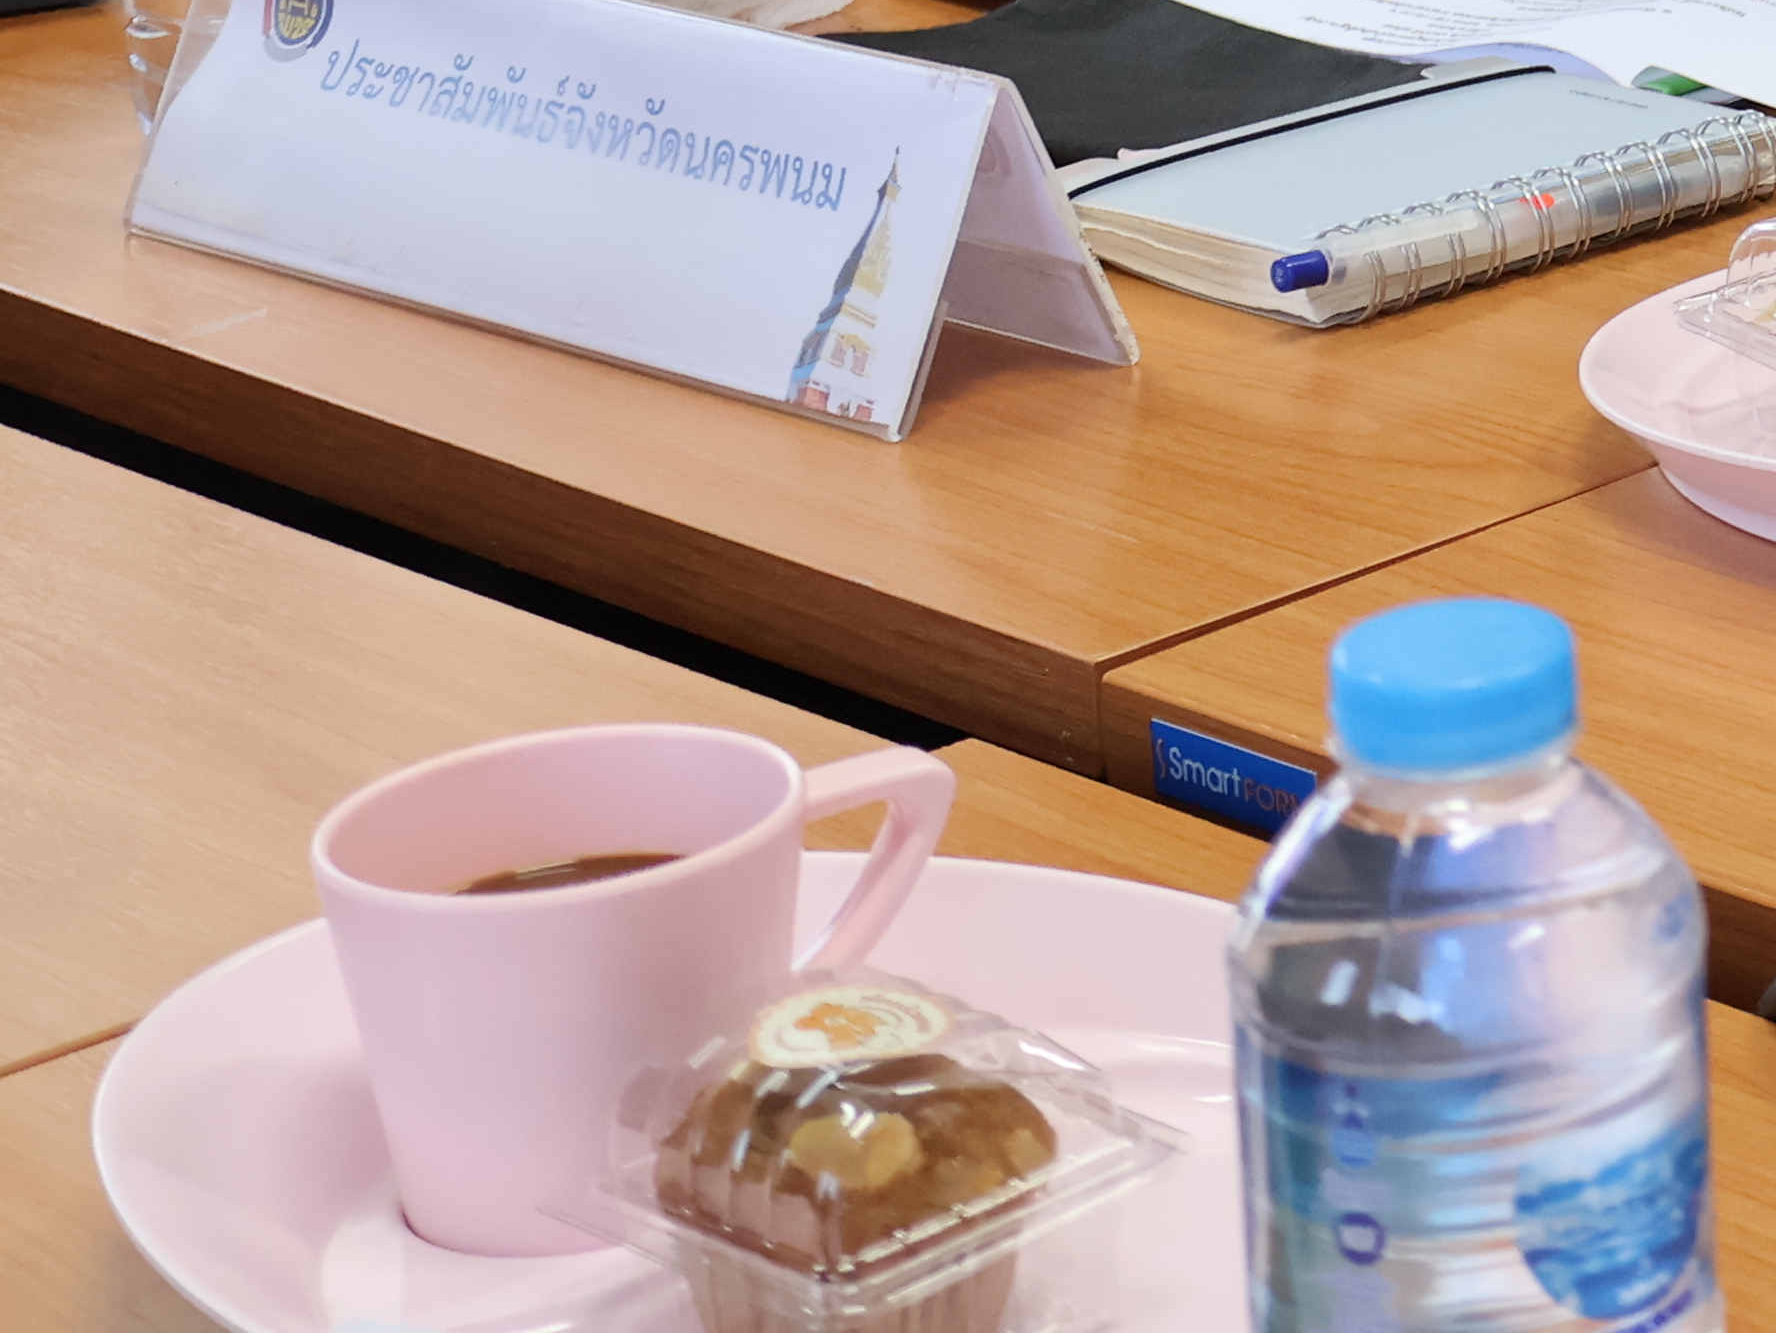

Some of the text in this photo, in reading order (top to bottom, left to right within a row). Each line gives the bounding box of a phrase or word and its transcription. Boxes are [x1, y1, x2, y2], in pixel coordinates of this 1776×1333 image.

[319, 37, 848, 212] ประชาสัมพันธ์จังหวัดนครพนม
